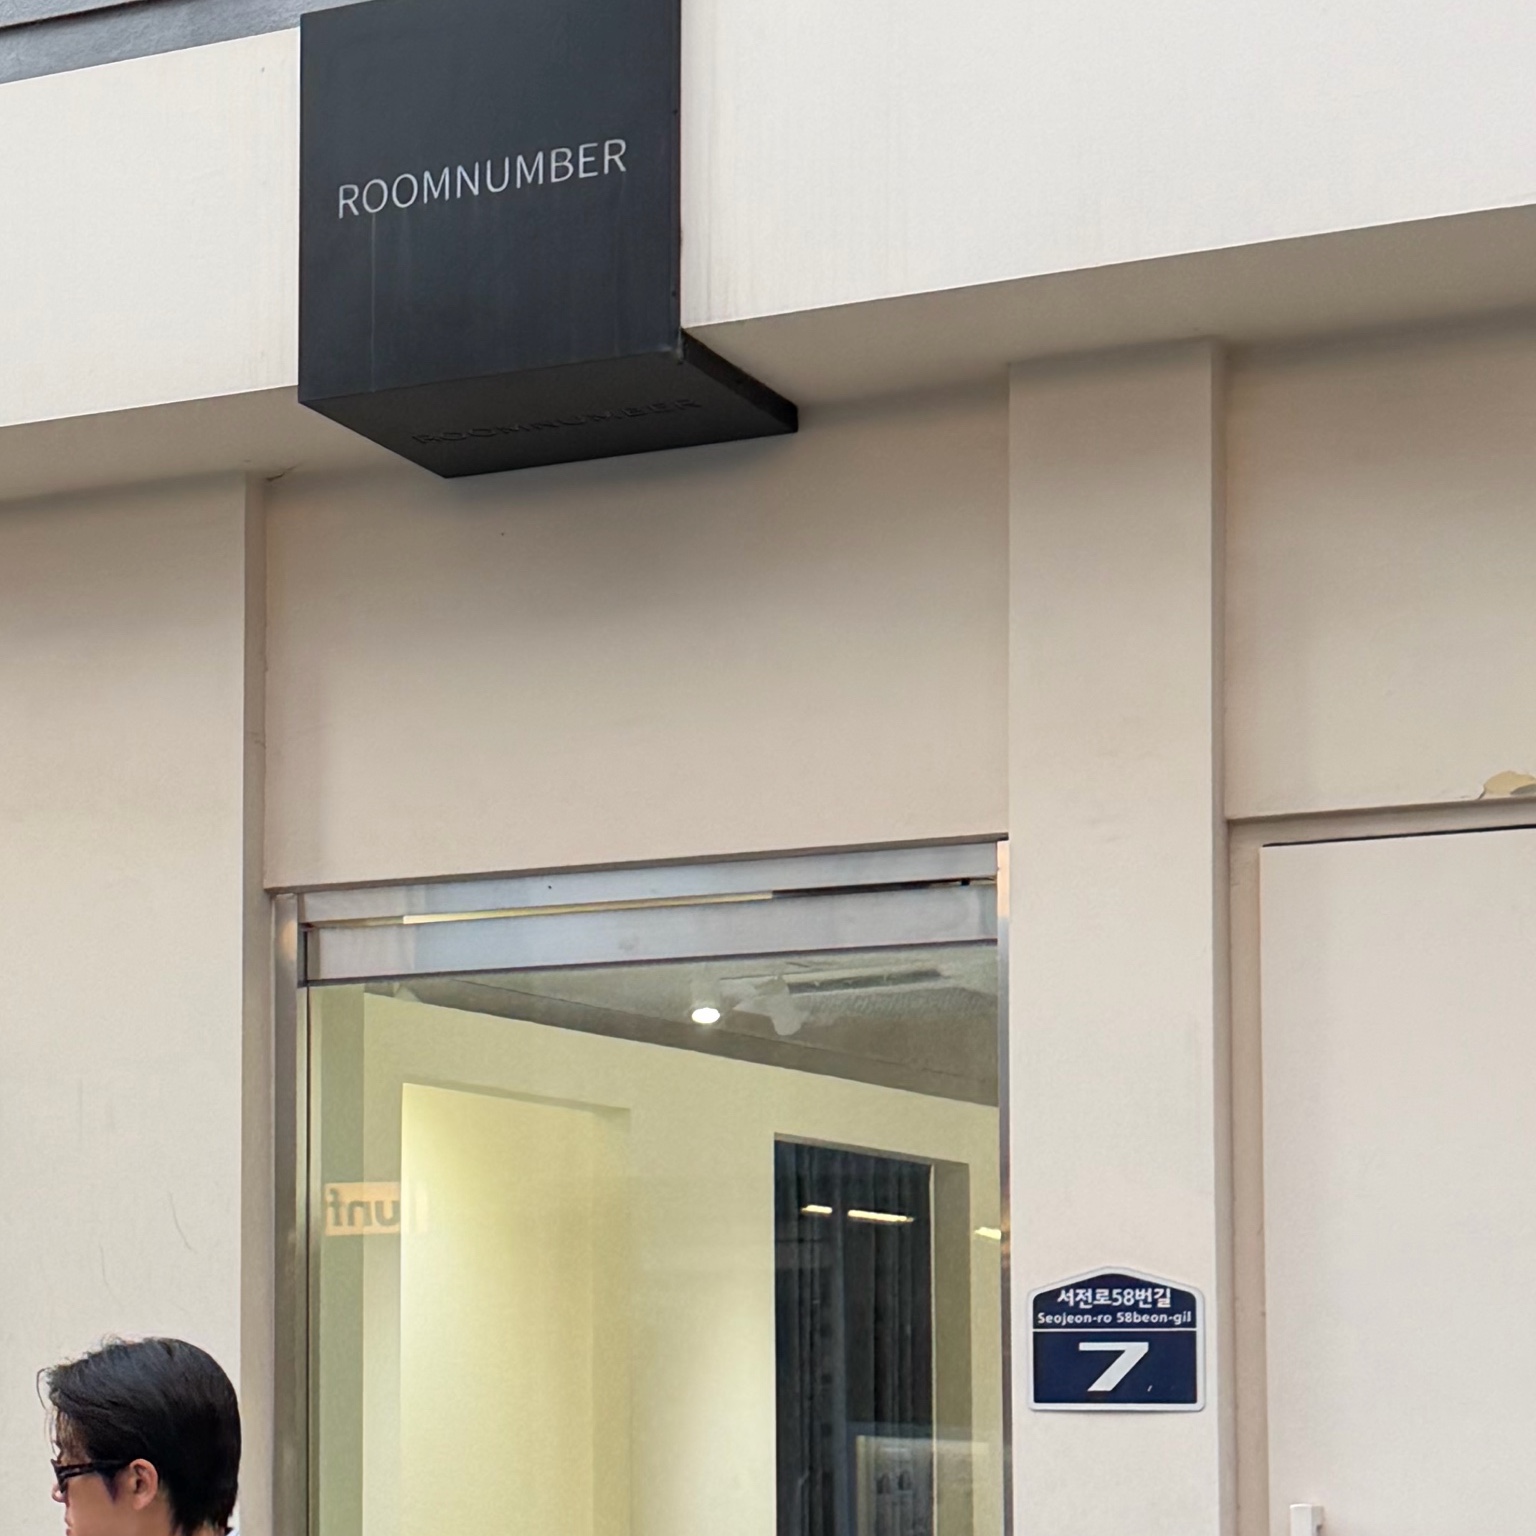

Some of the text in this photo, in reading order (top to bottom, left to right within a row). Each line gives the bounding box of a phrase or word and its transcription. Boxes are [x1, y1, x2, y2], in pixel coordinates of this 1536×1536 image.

[337, 138, 627, 219] ROOMNUMBER
[1057, 1287, 1172, 1309] 서전로58번길
[1037, 1311, 1192, 1326] Seojeon-ro 58beon-gil
[1078, 1341, 1150, 1392] 7
